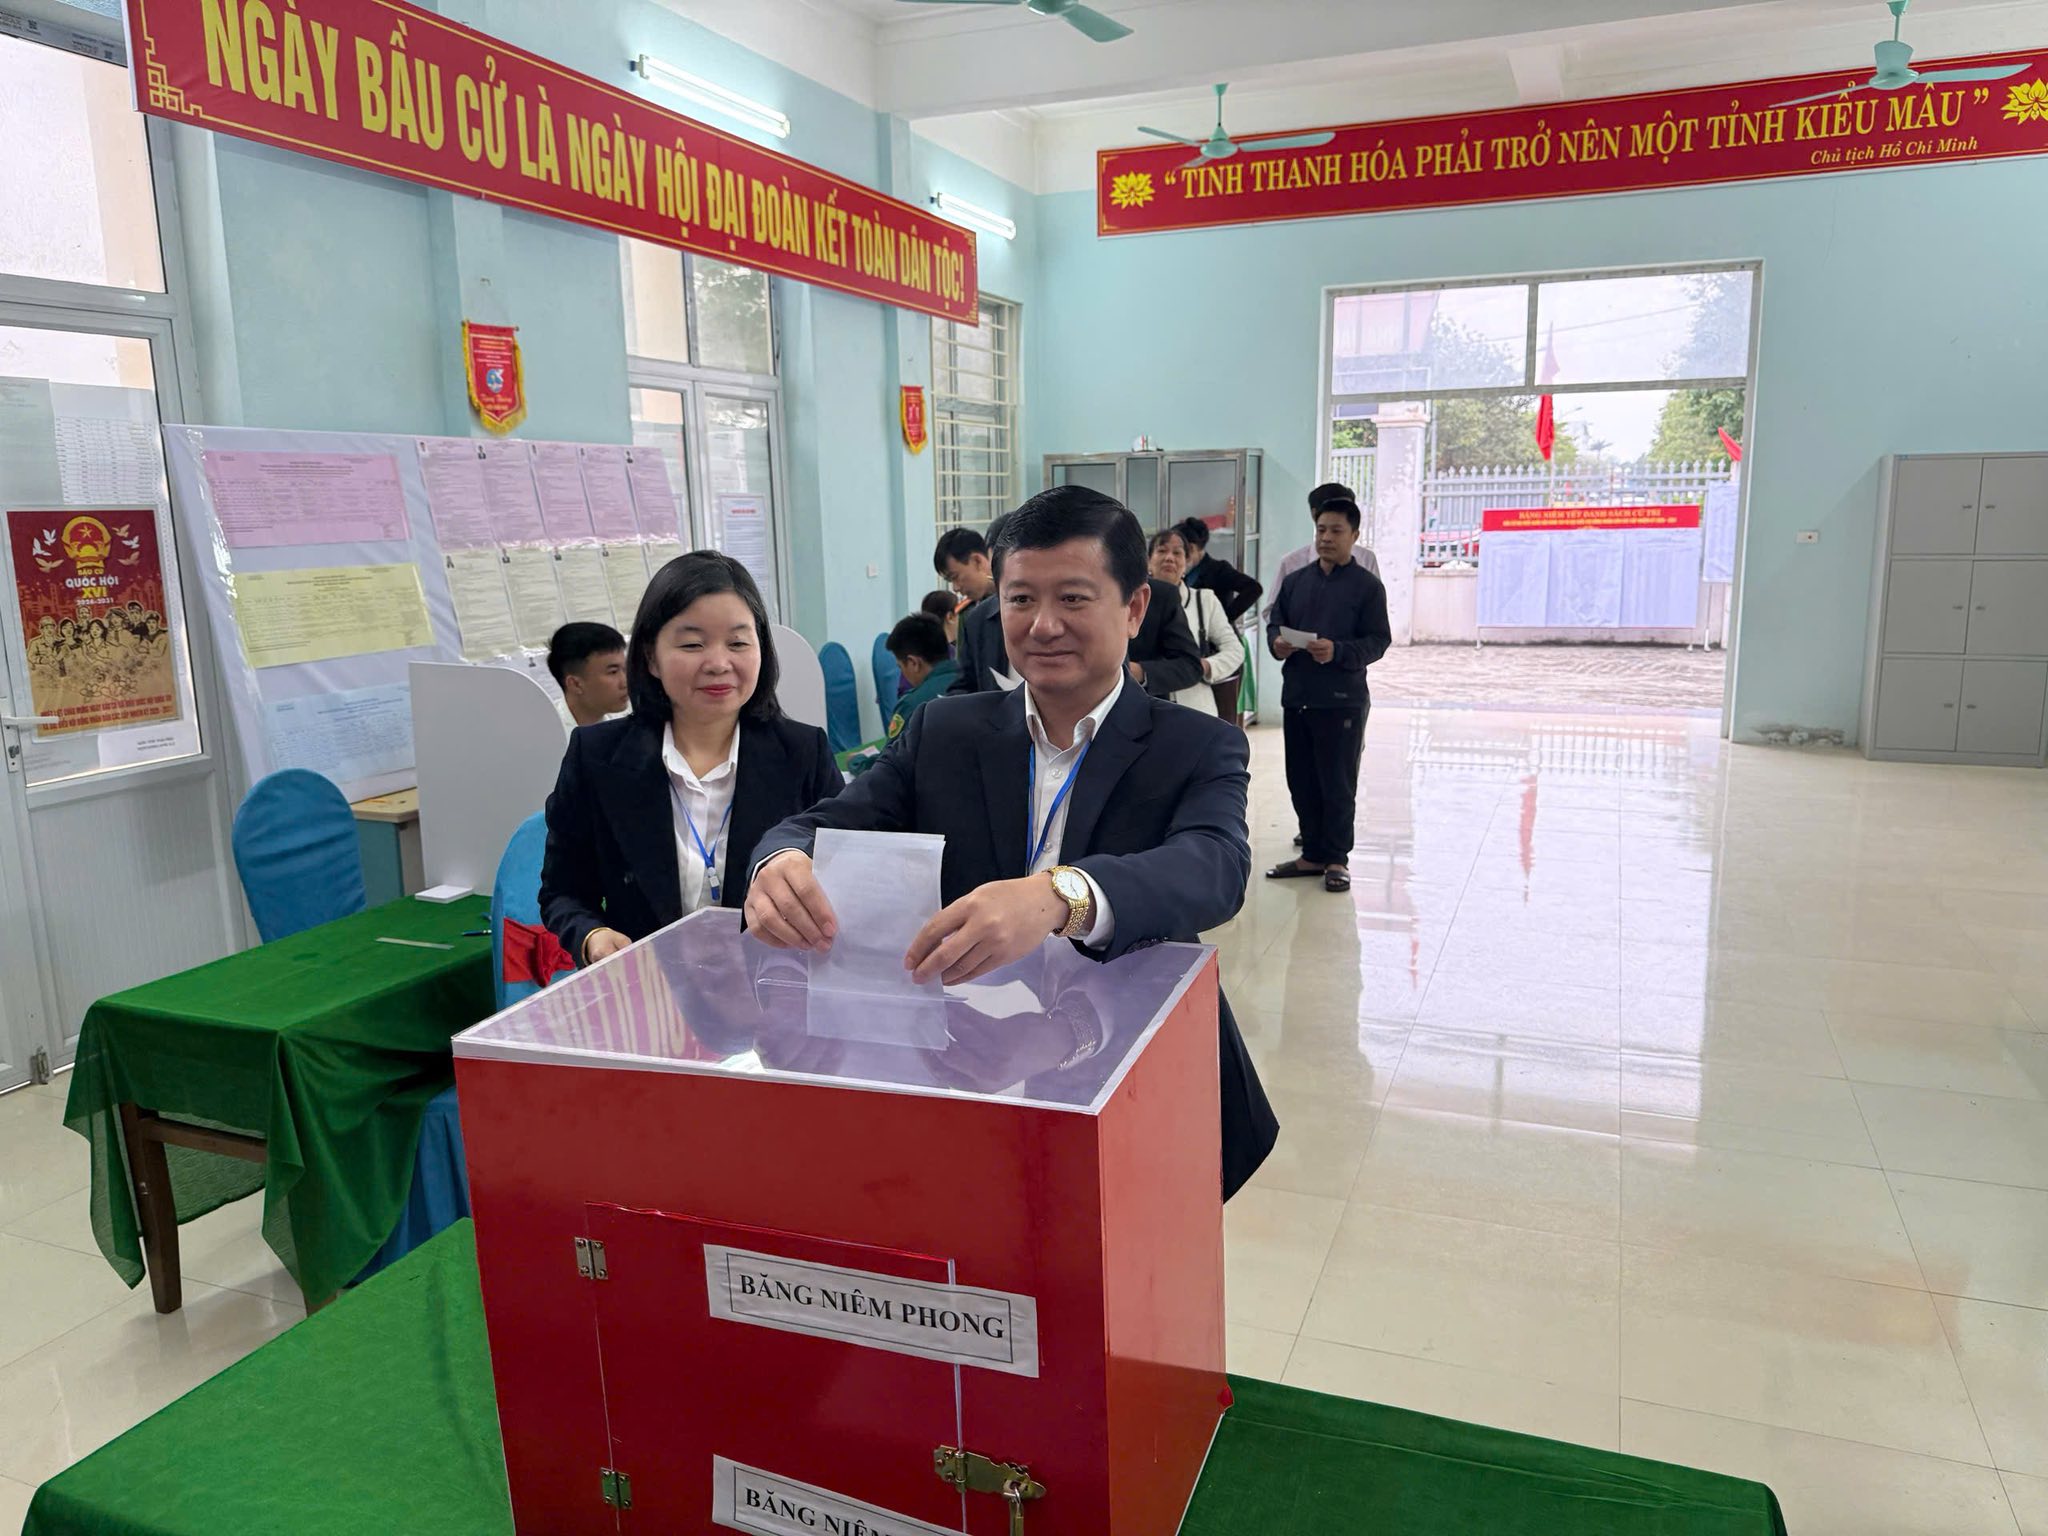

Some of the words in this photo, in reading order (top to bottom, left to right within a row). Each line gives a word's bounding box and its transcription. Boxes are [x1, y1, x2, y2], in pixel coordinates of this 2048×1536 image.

[201, 0, 339, 121] NGÀY
[355, 18, 444, 151] BẦU
[455, 55, 508, 169] CỬ
[516, 84, 561, 186] LÀ
[566, 112, 646, 210] NGÀY
[655, 137, 700, 238] HỘI
[705, 162, 747, 251] ĐẠI
[751, 175, 811, 258] ĐOÀN
[813, 188, 848, 269] KẾT
[852, 210, 897, 283] TOÀN
[900, 225, 931, 294] DÂN
[933, 238, 965, 310] TỘC!
[1251, 154, 1342, 192] THANH
[1349, 140, 1408, 183] HÓA
[1415, 128, 1484, 177] PHẢI
[1491, 120, 1551, 170] TRỞ
[1557, 118, 1622, 164] NÊN
[1629, 110, 1699, 164] MỘT
[1706, 100, 1787, 149] TỈNH
[1794, 80, 1879, 140] KIỂU
[1811, 147, 1841, 165] Chủ
[1846, 142, 1875, 164] tịch
[1879, 140, 1901, 158] Hồ
[1906, 139, 1933, 156] Chí
[1937, 136, 1978, 153] Minh
[82, 587, 107, 598] XVI
[740, 1273, 812, 1306] BĂNG
[820, 1289, 892, 1320] NIÊM
[901, 1302, 1004, 1339] PHONG
[745, 1487, 815, 1527] BĂNG
